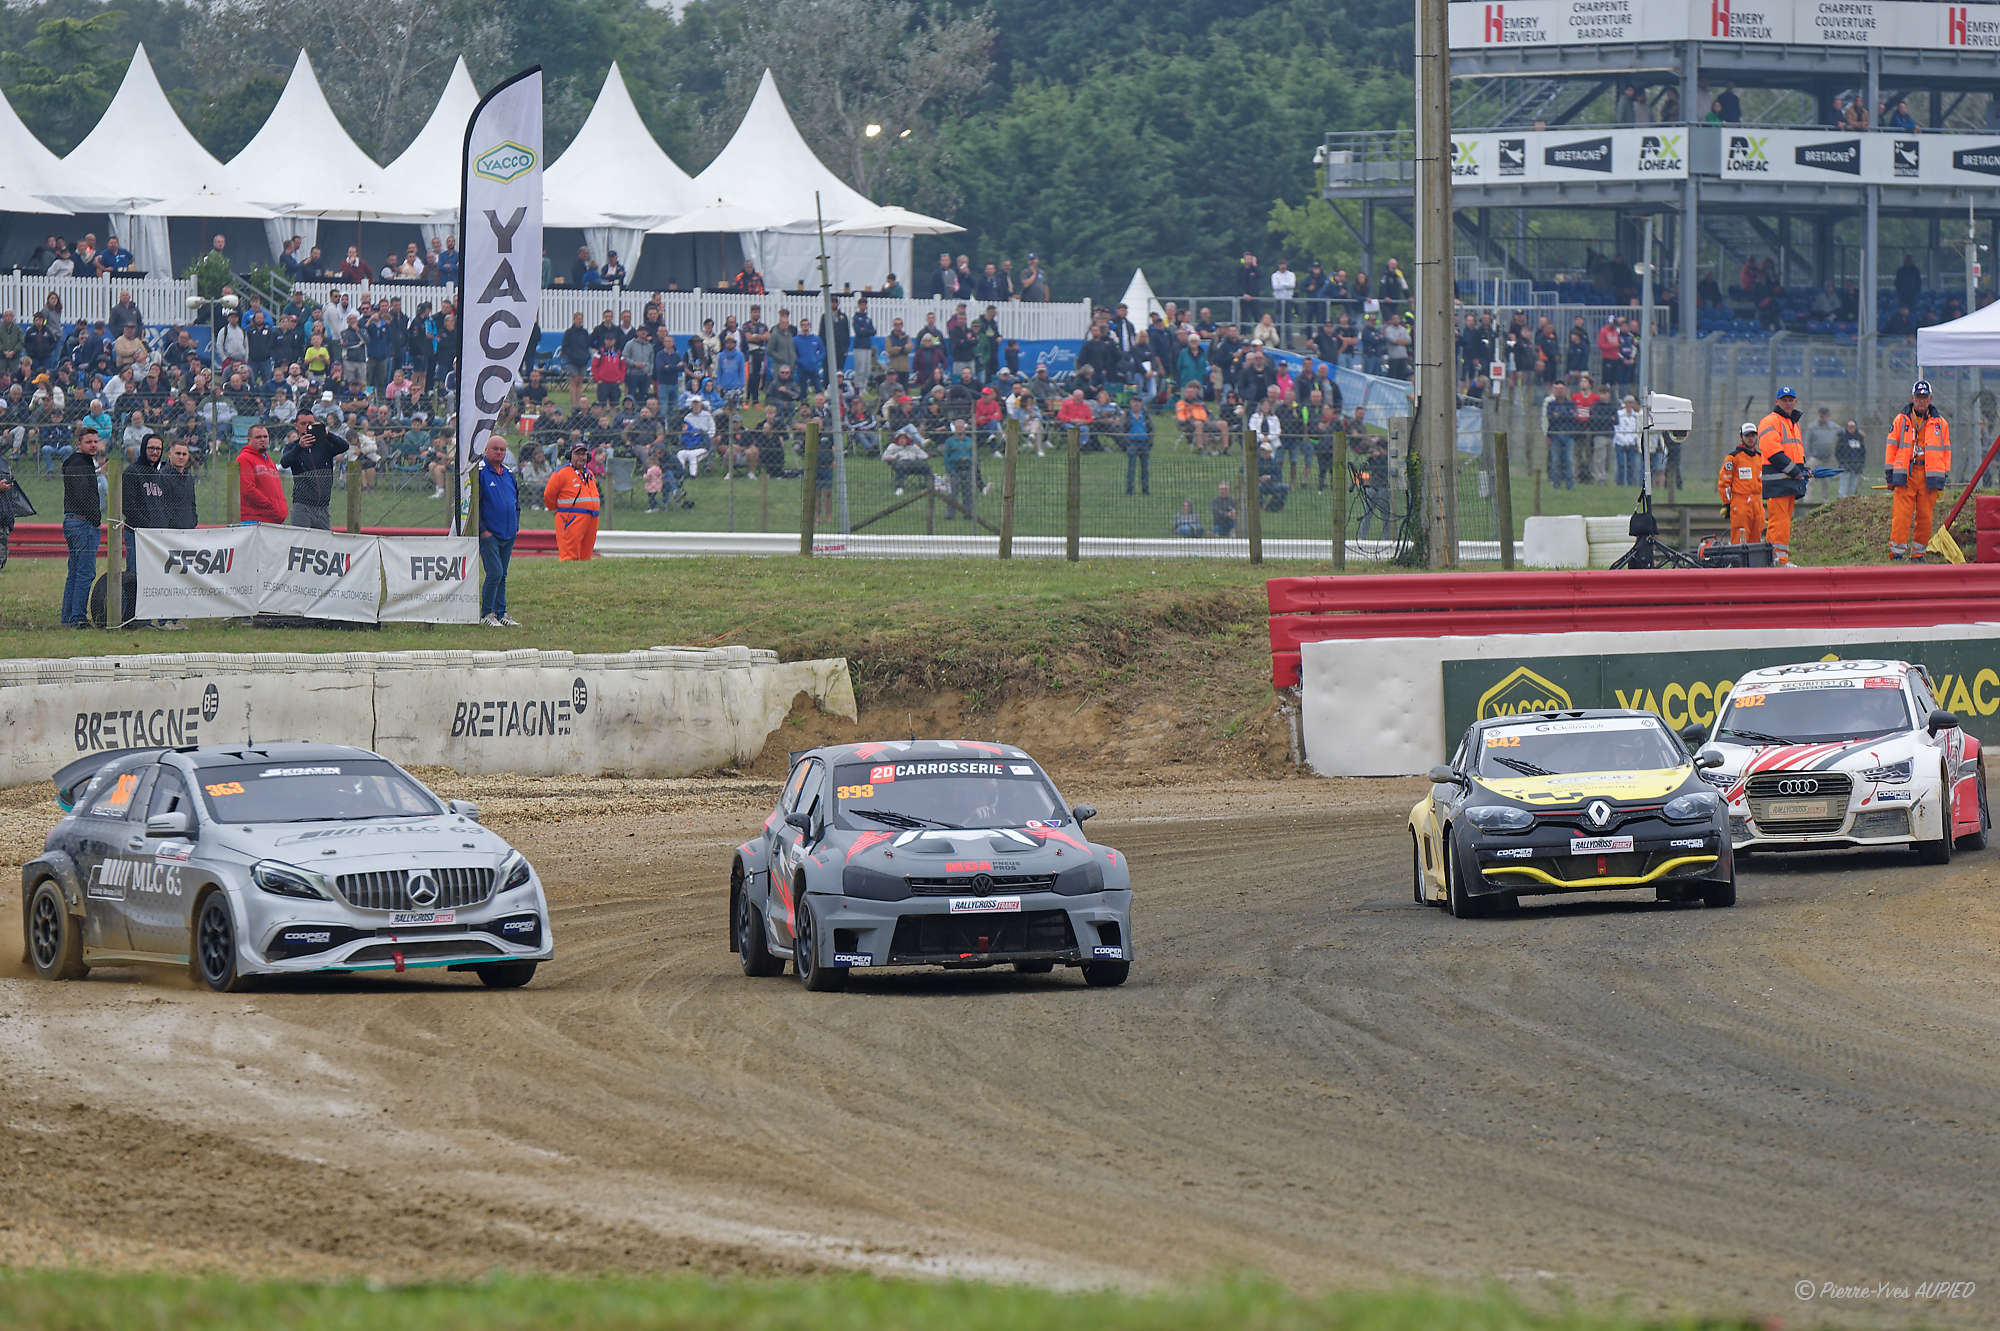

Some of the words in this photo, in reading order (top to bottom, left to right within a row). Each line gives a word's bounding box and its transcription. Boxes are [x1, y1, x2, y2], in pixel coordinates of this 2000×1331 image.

[1573, 1, 1629, 13] CHARPENTE
[1818, 3, 1873, 15] CHARPENTE
[1569, 14, 1632, 26] COUVERTURE
[1815, 16, 1876, 29] COUVERTURE
[1577, 28, 1624, 39] BARDAGE
[1823, 30, 1868, 41] BARDAGE
[1641, 135, 1681, 158] RX
[1730, 136, 1769, 159] RX
[1554, 150, 1602, 162] BRETAGNE
[1804, 150, 1850, 163] BRETAGNE
[1962, 154, 2000, 166] BRETAGN
[482, 154, 530, 171] YACCO
[1638, 159, 1682, 171] LOHEAC
[1727, 160, 1769, 172] LOHEAC
[164, 549, 229, 575] FFSA
[287, 546, 347, 577] FFSA
[410, 555, 463, 581] FFSA
[1929, 668, 2000, 716] YAC
[1734, 695, 1766, 709] 302
[450, 700, 571, 737] BRETAGNE
[74, 707, 200, 751] BRETAGNE
[1487, 736, 1521, 749] 342
[872, 766, 893, 779] 2D
[895, 763, 1004, 777] CARROSSERIE
[205, 782, 246, 797] 363
[836, 784, 874, 799] 393
[448, 826, 485, 835] 63
[1575, 839, 1613, 850] RALLYCROSS
[1612, 841, 1632, 850] FRANCE
[1670, 838, 1704, 848] COOPER
[1497, 848, 1534, 857] COOPER
[132, 861, 164, 893] MLC
[954, 900, 997, 910] RALLYCROSS
[996, 902, 1019, 910] FRANCE
[394, 912, 435, 923] RALLYCROSS
[503, 920, 536, 930] COOPER
[284, 932, 331, 941] COOPER
[1094, 947, 1123, 955] COOPER
[834, 954, 872, 964] COOPER
